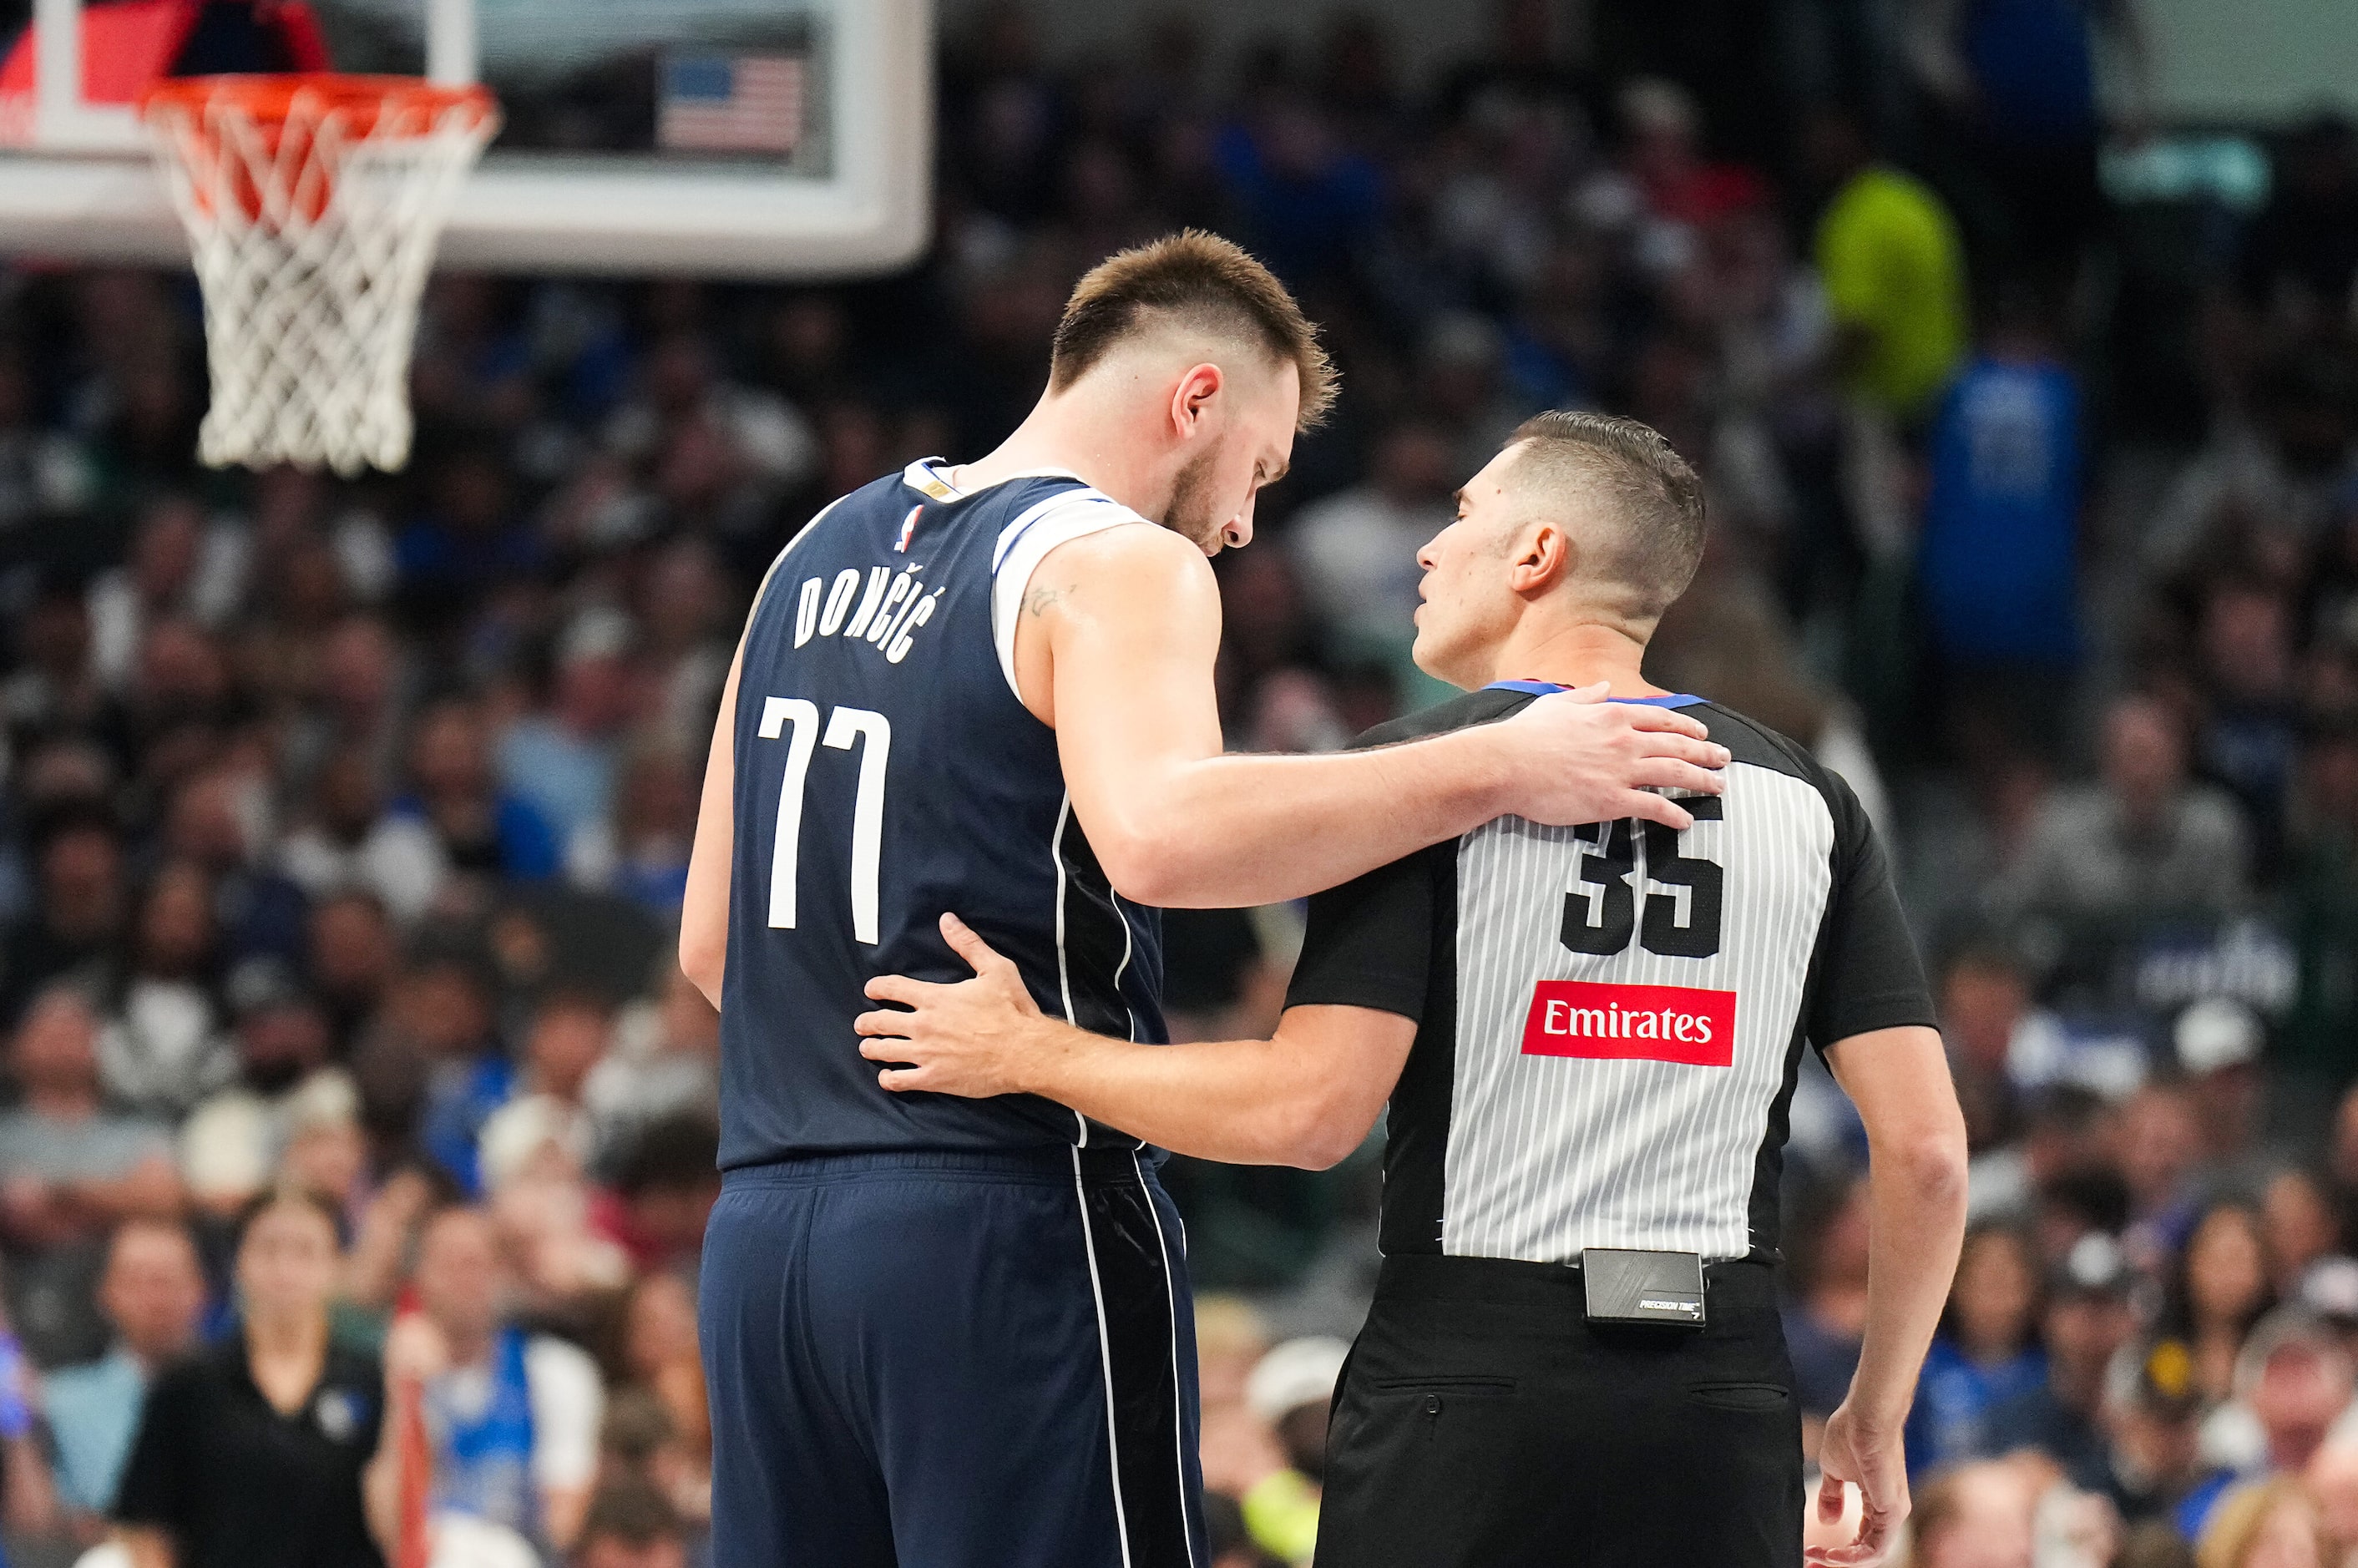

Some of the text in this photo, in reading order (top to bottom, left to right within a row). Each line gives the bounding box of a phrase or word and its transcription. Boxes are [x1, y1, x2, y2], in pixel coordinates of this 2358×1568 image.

[794, 563, 946, 665] DONČIĆ
[757, 695, 892, 946] 77
[1560, 796, 1723, 959] 35
[1544, 999, 1713, 1044] Emirates
[1639, 1300, 1678, 1310] PRECISION
